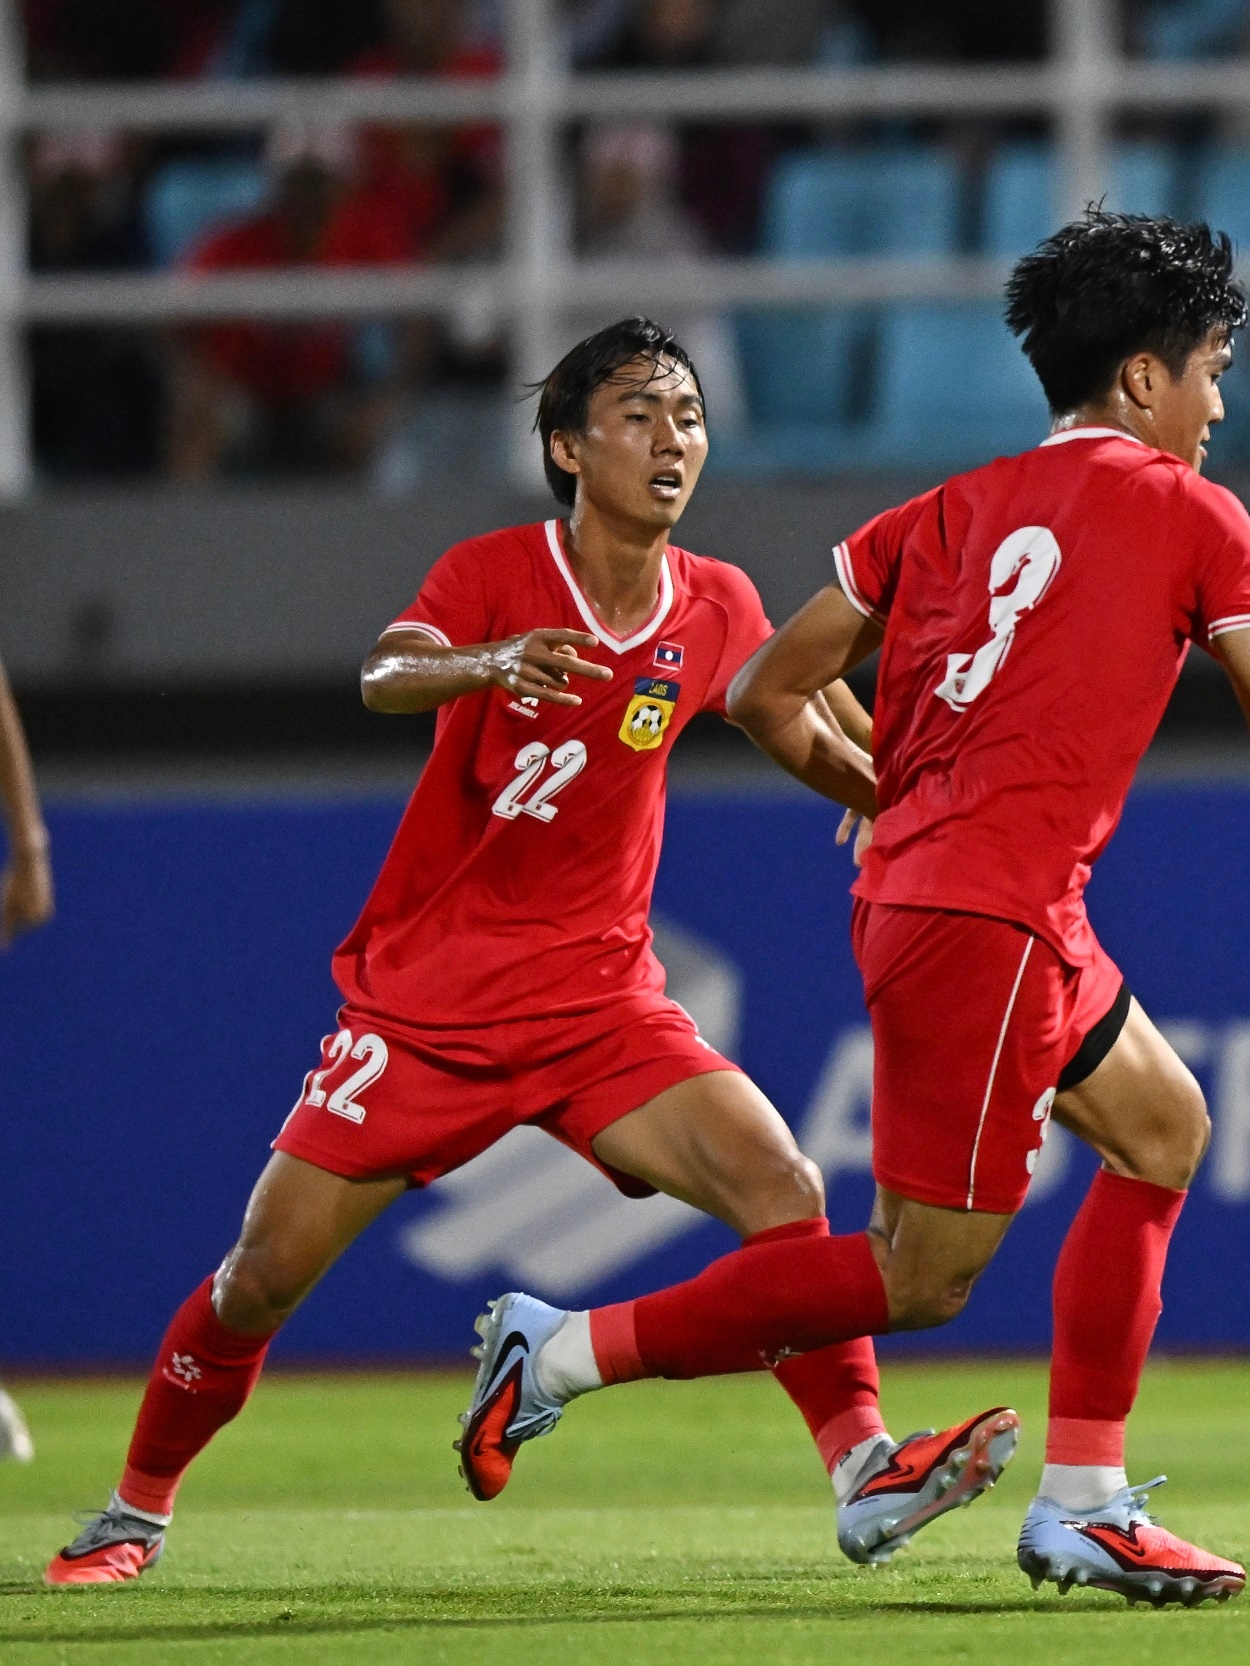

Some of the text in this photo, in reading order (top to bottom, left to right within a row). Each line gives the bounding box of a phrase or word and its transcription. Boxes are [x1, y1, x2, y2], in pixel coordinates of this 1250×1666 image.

[933, 525, 1062, 713] 3
[491, 739, 587, 823] 22
[305, 1029, 388, 1124] 22
